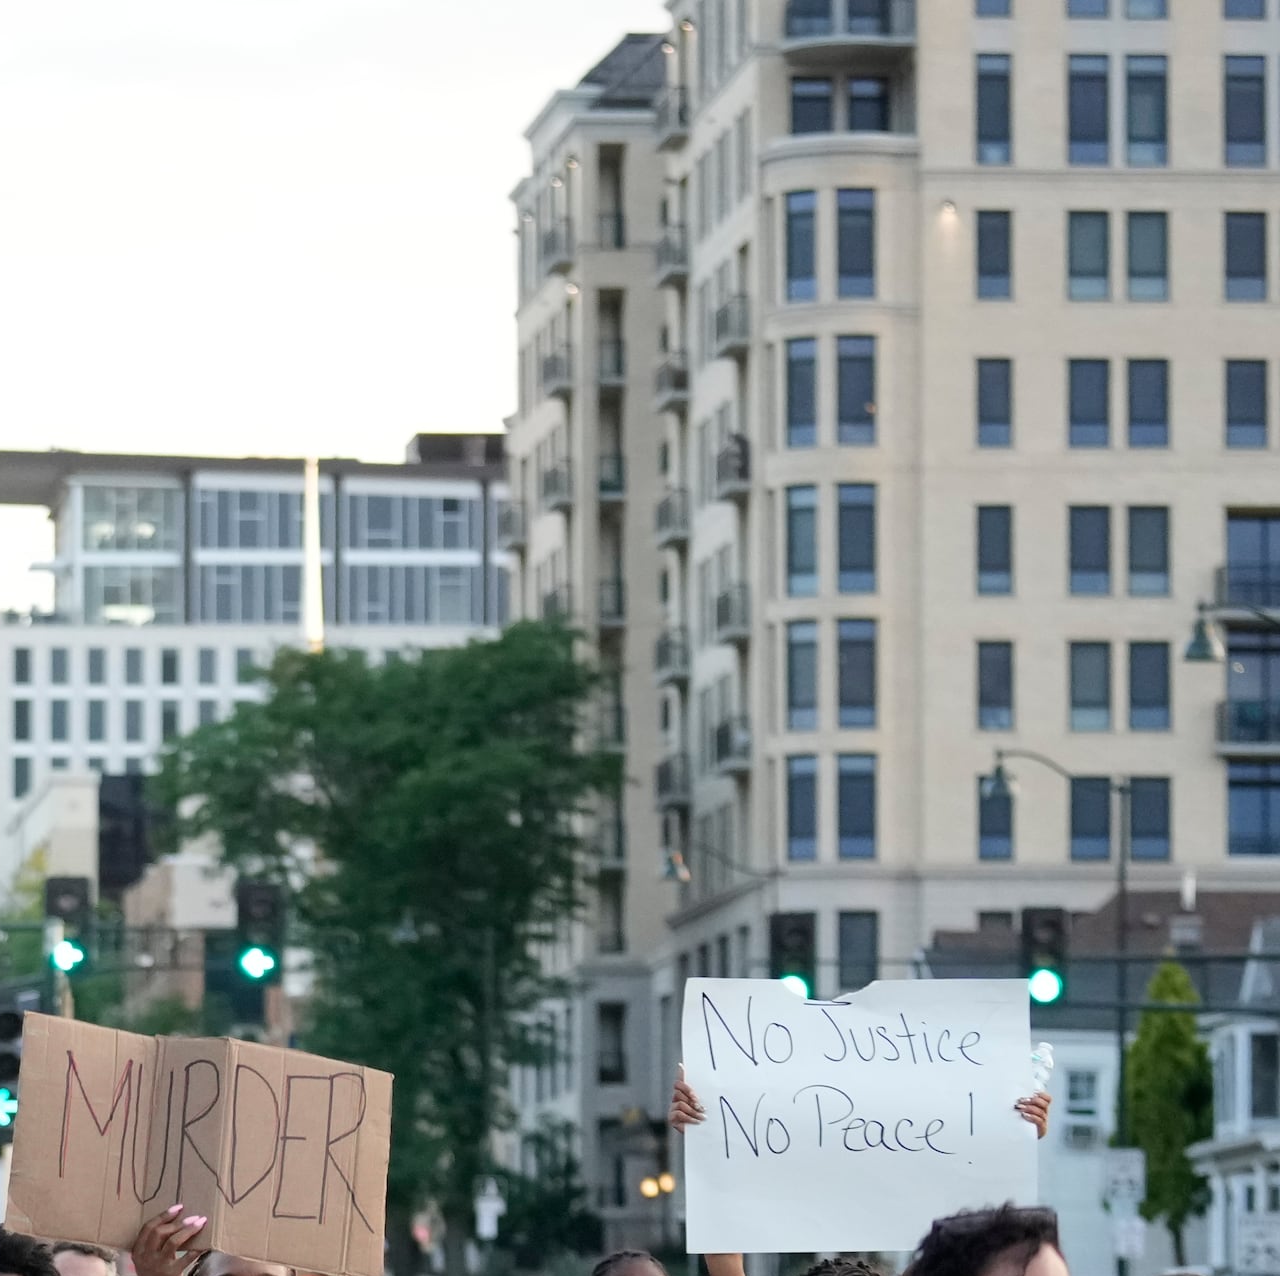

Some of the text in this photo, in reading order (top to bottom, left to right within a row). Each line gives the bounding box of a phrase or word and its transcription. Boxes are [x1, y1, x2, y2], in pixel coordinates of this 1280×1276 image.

[701, 991, 984, 1071] No Justice
[58, 1050, 375, 1234] MURDER
[719, 1093, 791, 1159] No
